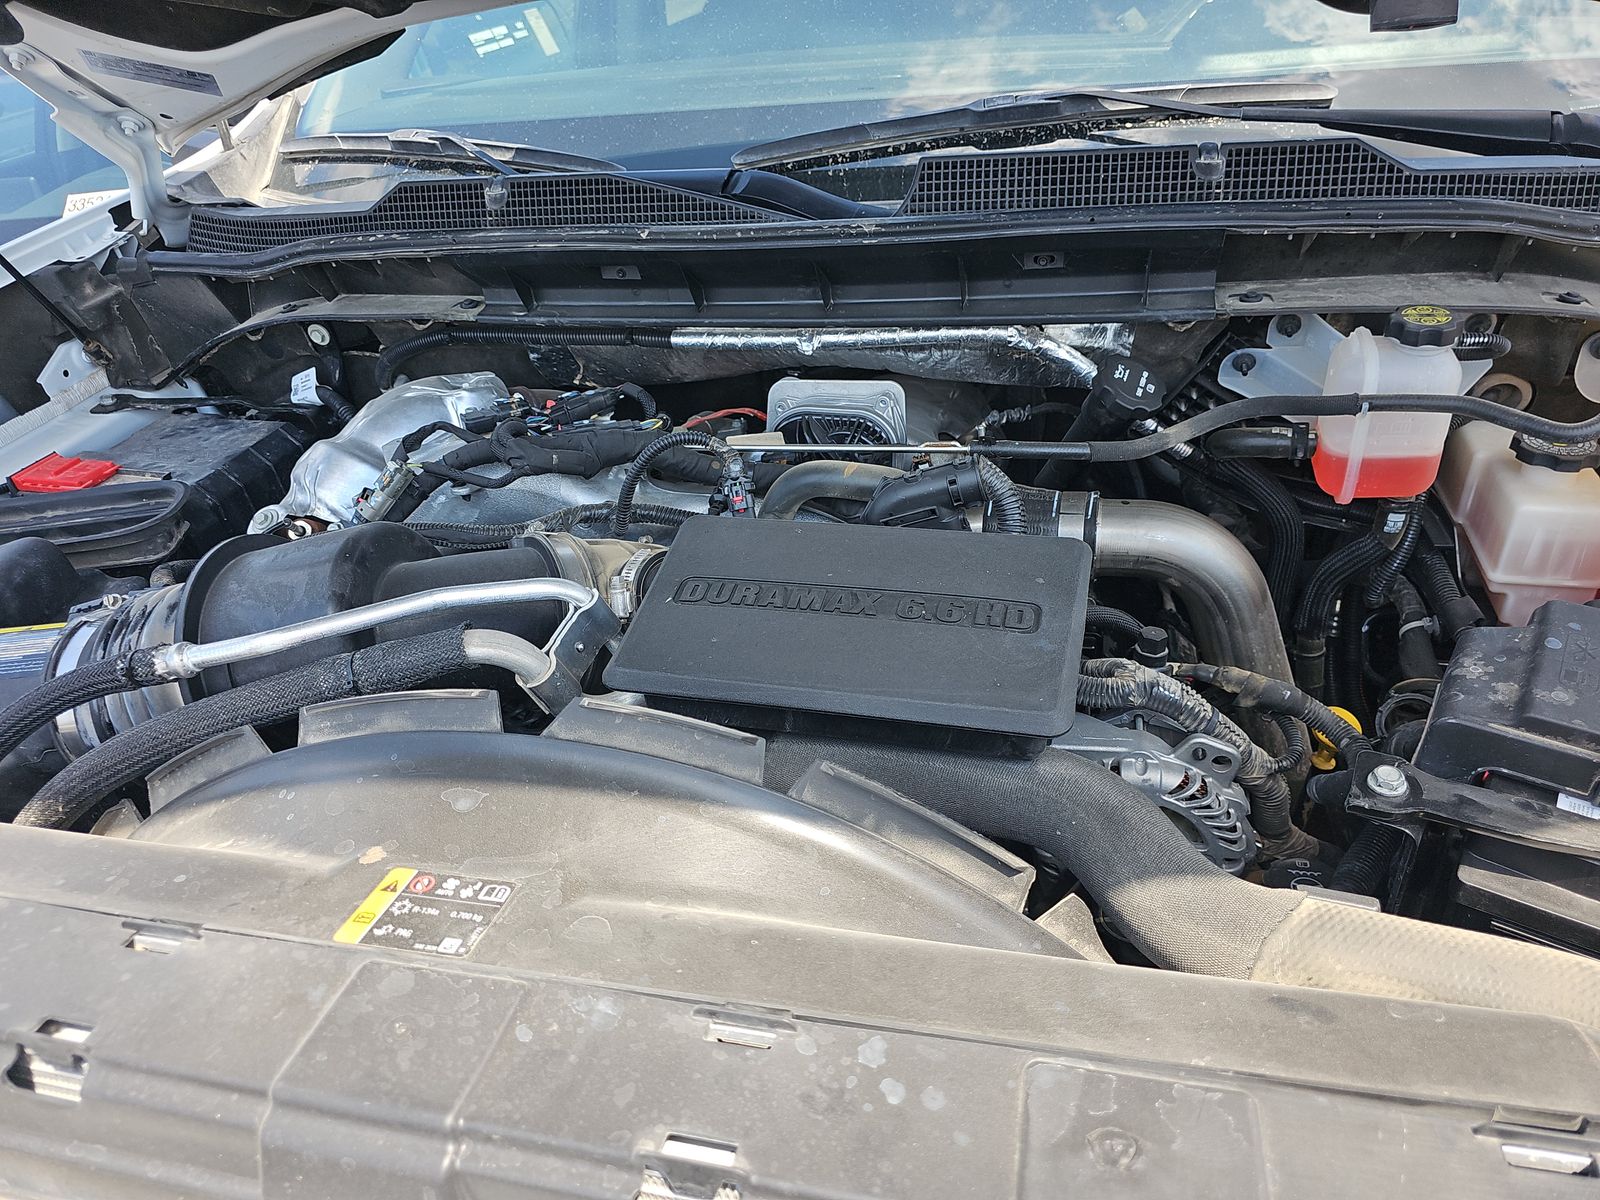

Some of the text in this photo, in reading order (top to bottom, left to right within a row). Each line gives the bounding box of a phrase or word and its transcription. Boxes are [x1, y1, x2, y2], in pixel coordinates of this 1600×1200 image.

[678, 578, 1036, 632] DURAMAX 6.6 HD
